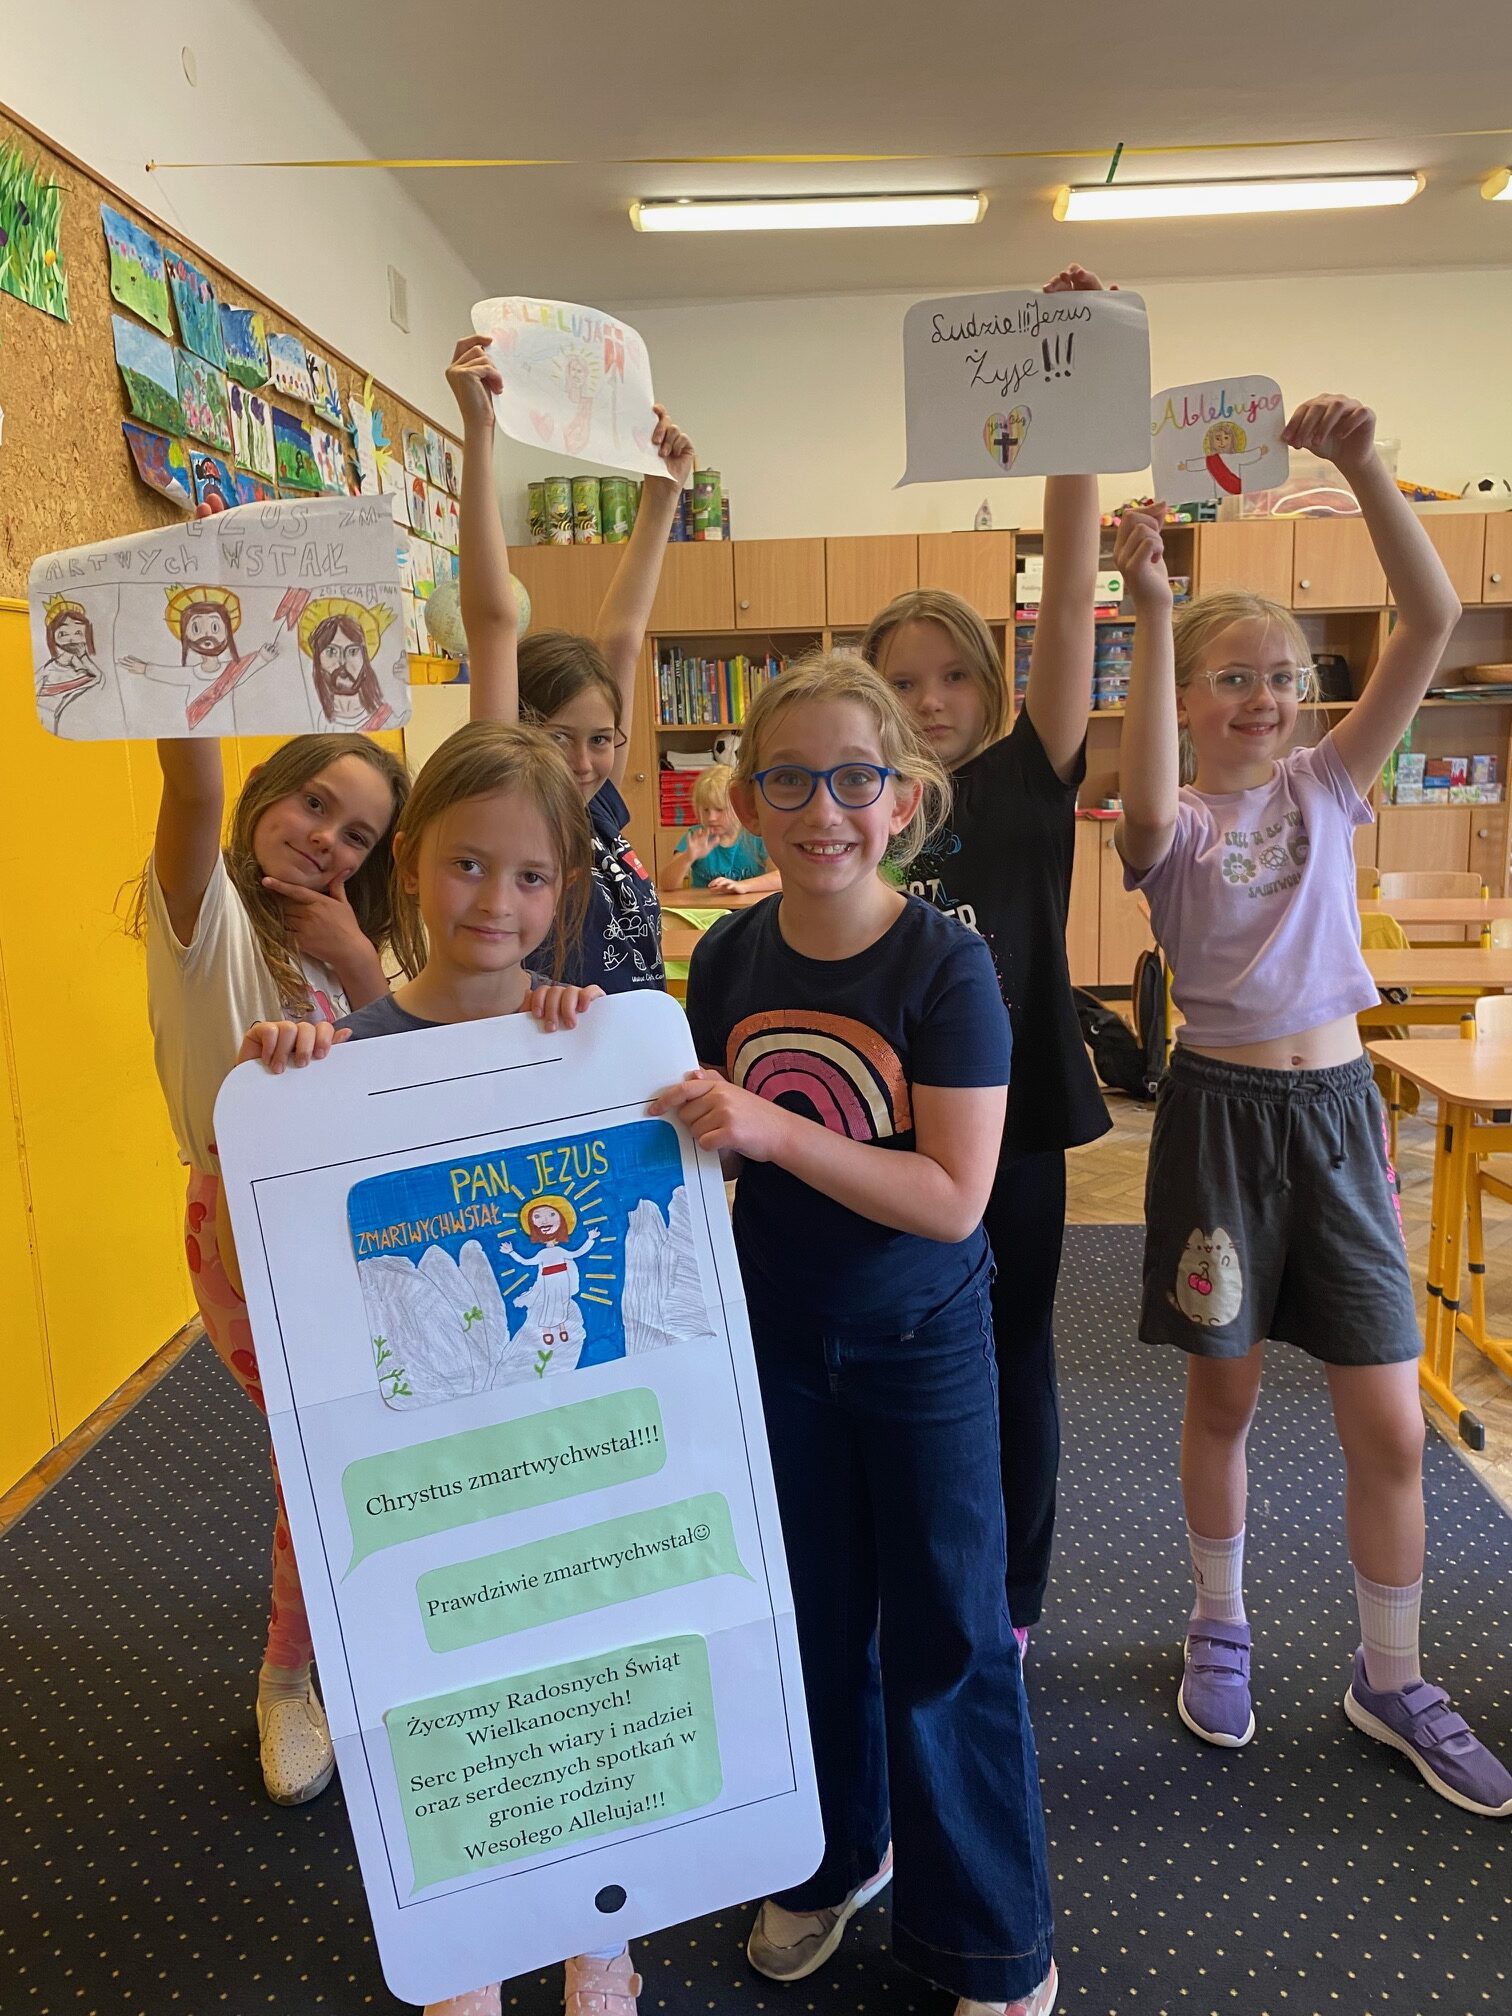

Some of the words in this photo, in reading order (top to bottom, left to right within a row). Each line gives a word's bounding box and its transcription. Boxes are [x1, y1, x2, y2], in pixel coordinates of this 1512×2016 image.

[1027, 300, 1092, 338] Jezus
[450, 1160, 509, 1204] PAN
[527, 1140, 608, 1196] JEZUS
[355, 1202, 503, 1255] ZMARTWYCHWSTAŁ
[366, 1479, 463, 1517] Chrystus
[468, 1425, 660, 1490] zmartwychwstał!!!
[427, 1573, 539, 1617] Prawdziwie
[543, 1528, 695, 1586] zmartwychwstał
[407, 1701, 501, 1737] Życzymy
[507, 1667, 619, 1709] Radosnych
[625, 1652, 681, 1678] Świąt
[466, 1689, 632, 1746] Wielkanocnych!
[411, 1771, 457, 1792] Serc
[463, 1744, 543, 1783] pełnych
[549, 1728, 604, 1755] wiary
[610, 1722, 617, 1738] i
[624, 1701, 693, 1735] nadziei
[415, 1798, 461, 1818] oraz
[466, 1755, 590, 1804] serdecznych
[596, 1732, 675, 1770] spotkań
[681, 1728, 697, 1742] w
[464, 1824, 563, 1861] Wesołego
[569, 1791, 665, 1833] Alleluja!!!
[489, 1795, 555, 1829] gronie
[560, 1773, 636, 1805] rodziny
